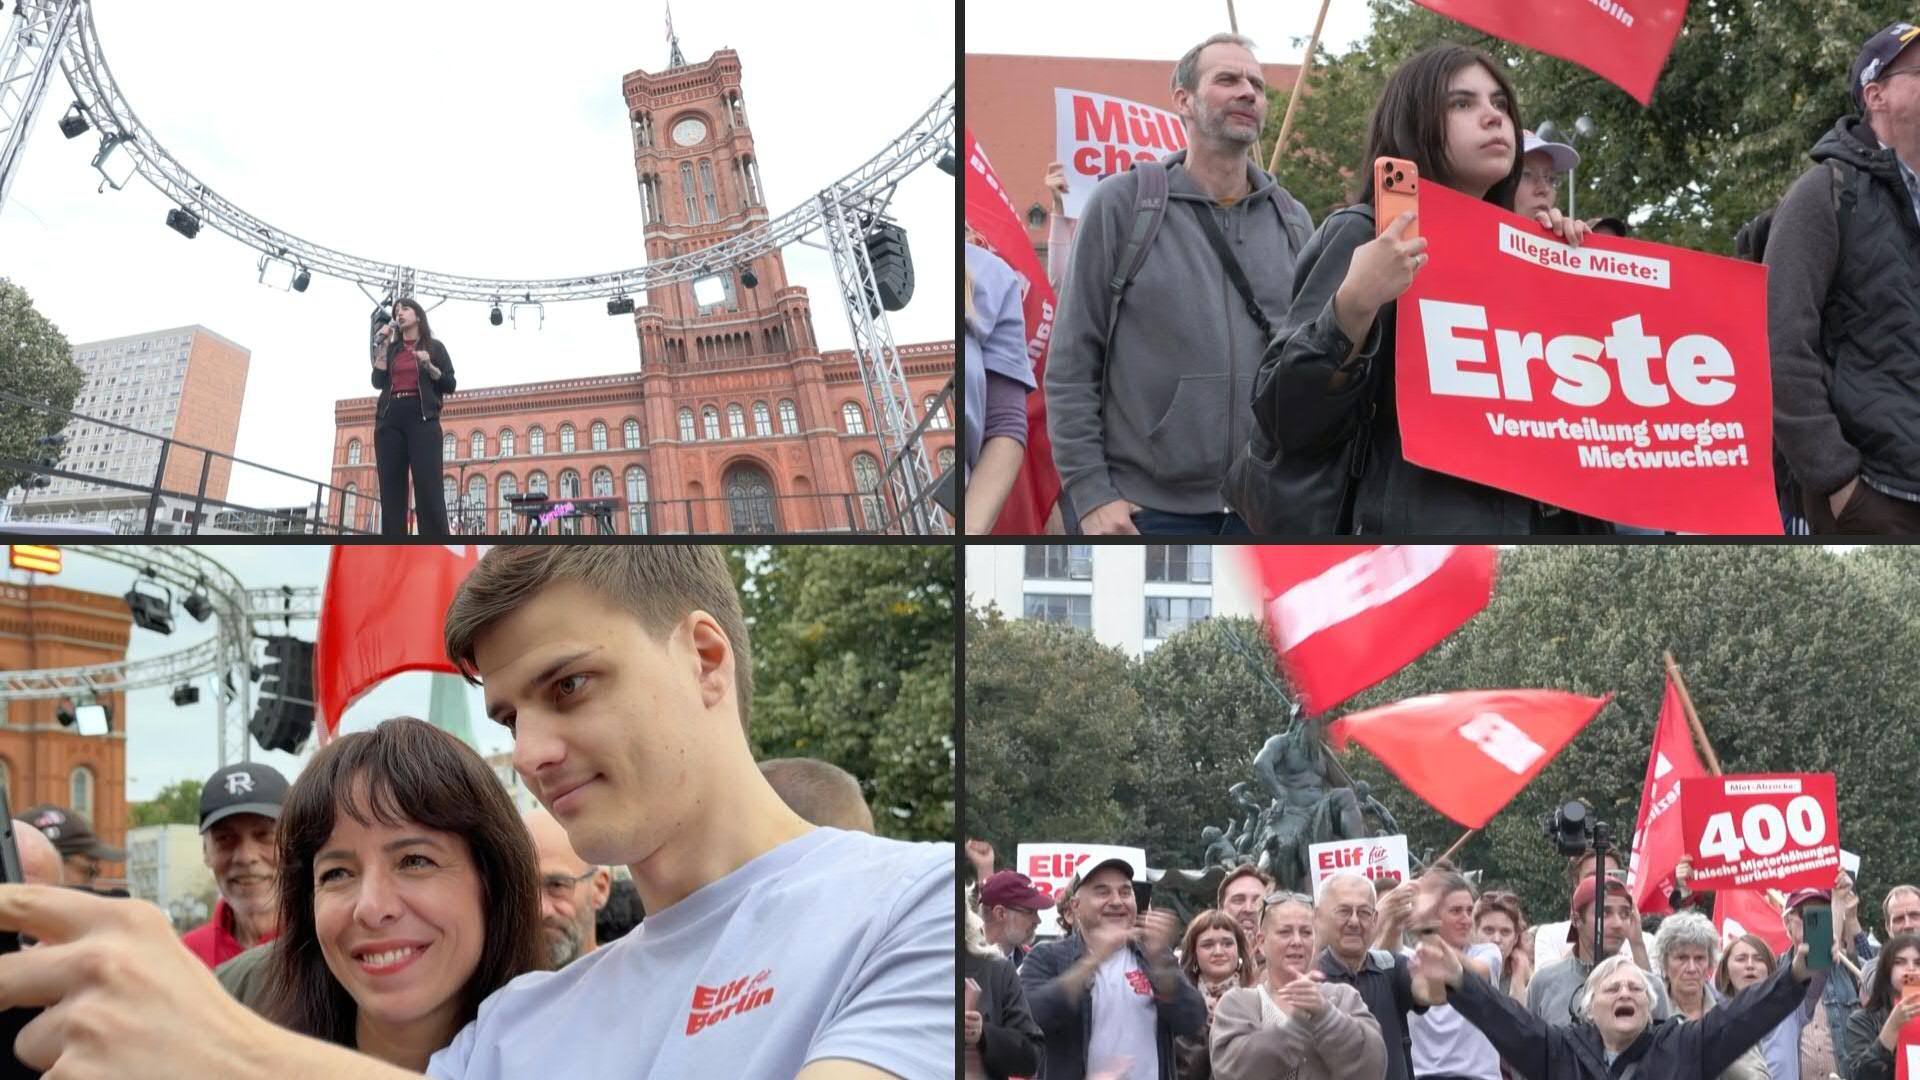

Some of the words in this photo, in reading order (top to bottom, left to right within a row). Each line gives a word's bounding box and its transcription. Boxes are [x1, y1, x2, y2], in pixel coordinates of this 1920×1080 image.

[1072, 95, 1187, 152] Müll
[1509, 233, 1582, 269] Illegale
[1589, 254, 1658, 281] Miete:
[1418, 298, 1737, 408] Erste
[1486, 412, 1651, 447] Verurteilung
[1653, 418, 1744, 446] wegen
[1578, 444, 1749, 469] Mietwucher!
[1699, 795, 1826, 863] 400
[1318, 847, 1363, 870] Elif
[1693, 863, 1738, 881] falsche
[1740, 845, 1836, 872] Mieterhöhungen
[1734, 855, 1838, 885] zurückgenommen
[692, 975, 749, 1010] Elif
[686, 987, 774, 1036] Berlin
